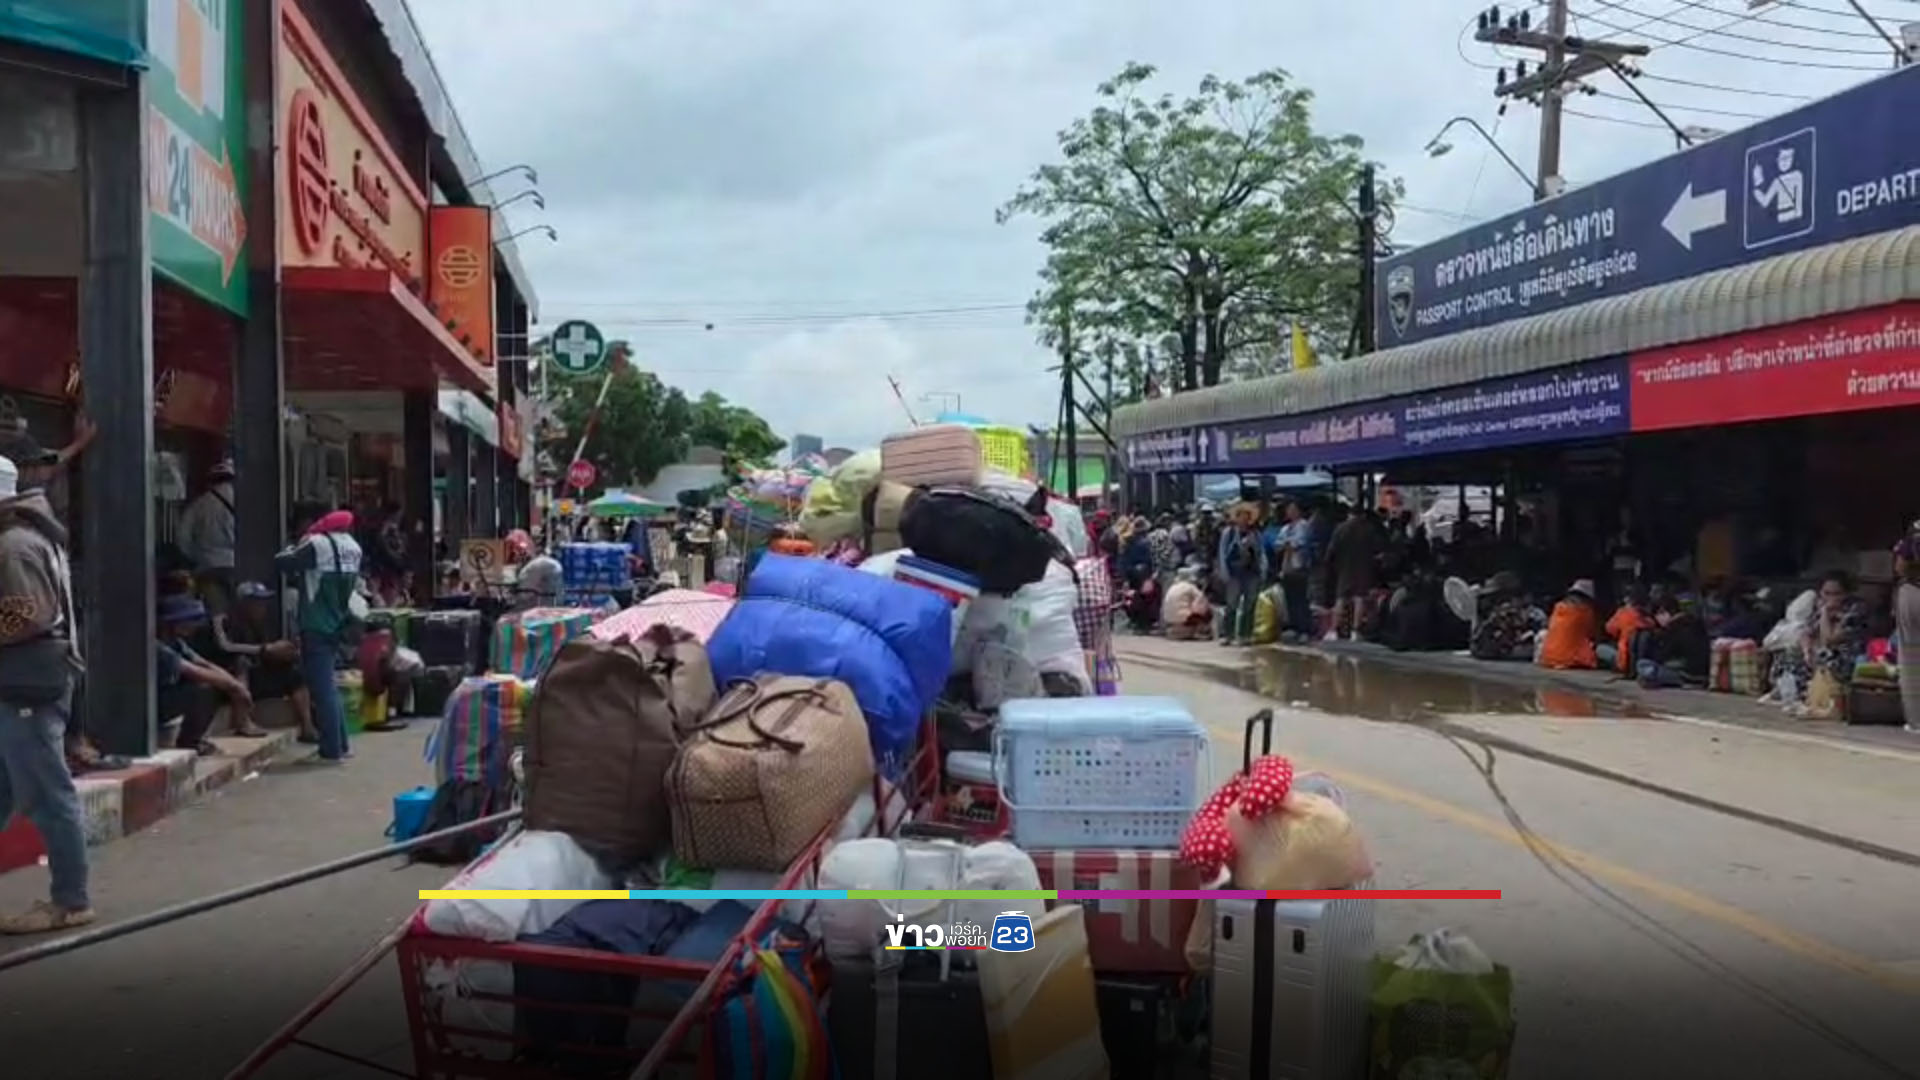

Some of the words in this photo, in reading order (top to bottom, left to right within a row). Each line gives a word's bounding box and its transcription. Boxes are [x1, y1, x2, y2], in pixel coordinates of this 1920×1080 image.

[168, 134, 190, 225] 24
[1837, 168, 1920, 215] DEPART
[1435, 207, 1615, 288] ตรวจหนังสือเดินทาง
[1416, 299, 1463, 327] PASSPORT
[1465, 286, 1514, 315] CONTROL
